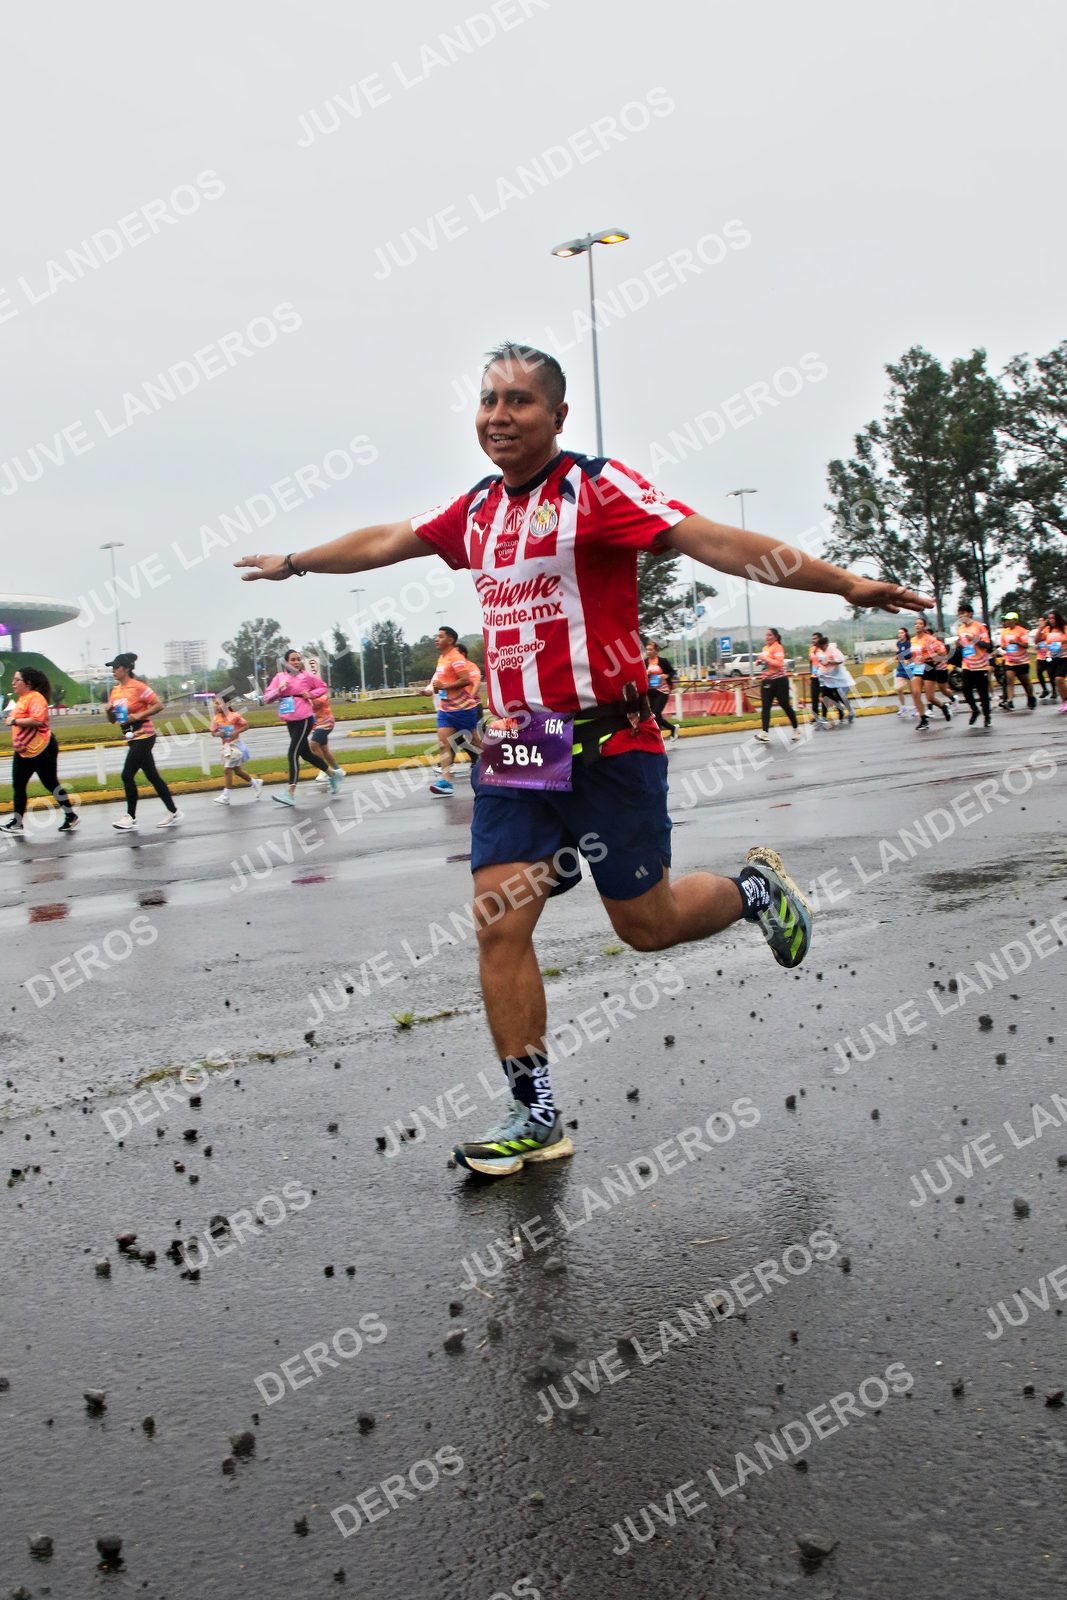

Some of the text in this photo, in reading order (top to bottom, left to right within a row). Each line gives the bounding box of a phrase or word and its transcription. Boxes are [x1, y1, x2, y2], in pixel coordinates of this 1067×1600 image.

[475, 572, 561, 608] Caliente
[500, 640, 544, 656] mercado
[500, 655, 524, 669] pago
[501, 744, 543, 766] 384
